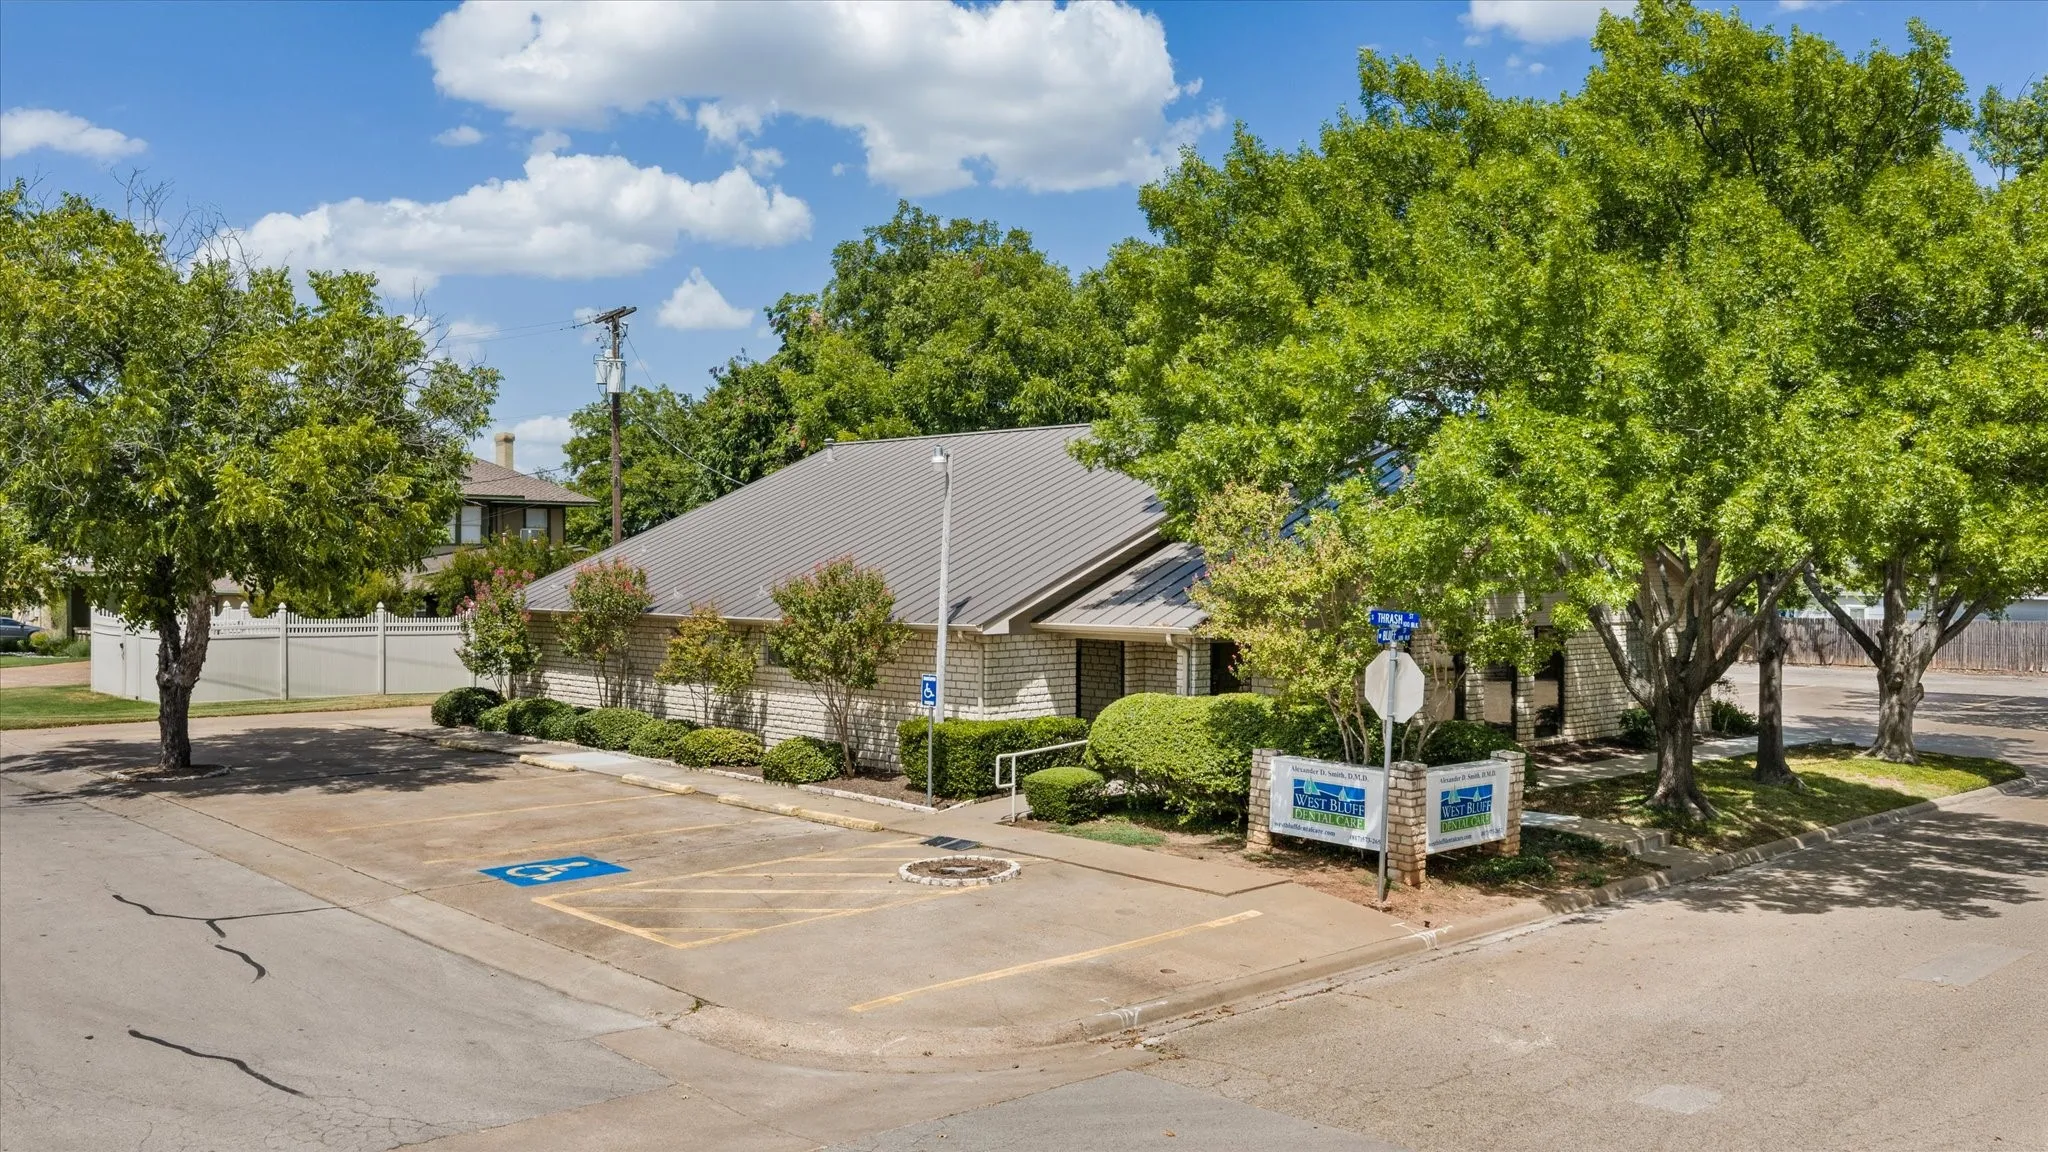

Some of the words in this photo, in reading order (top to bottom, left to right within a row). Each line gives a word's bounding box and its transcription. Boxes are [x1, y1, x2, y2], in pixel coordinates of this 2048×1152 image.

[1377, 613, 1403, 625] THRASH
[1291, 765, 1319, 775] Alexander
[1328, 770, 1347, 779] Smith,
[1348, 773, 1369, 782] D.M.D.
[1295, 793, 1327, 810] WEST
[1330, 798, 1365, 816] BLUFF
[1442, 804, 1466, 818] WEST
[1467, 800, 1492, 814] BLUFF
[1295, 809, 1333, 822] DENTAL
[1336, 816, 1364, 829] CARE
[1442, 817, 1471, 832] DENTAL
[1471, 813, 1492, 826] CARE
